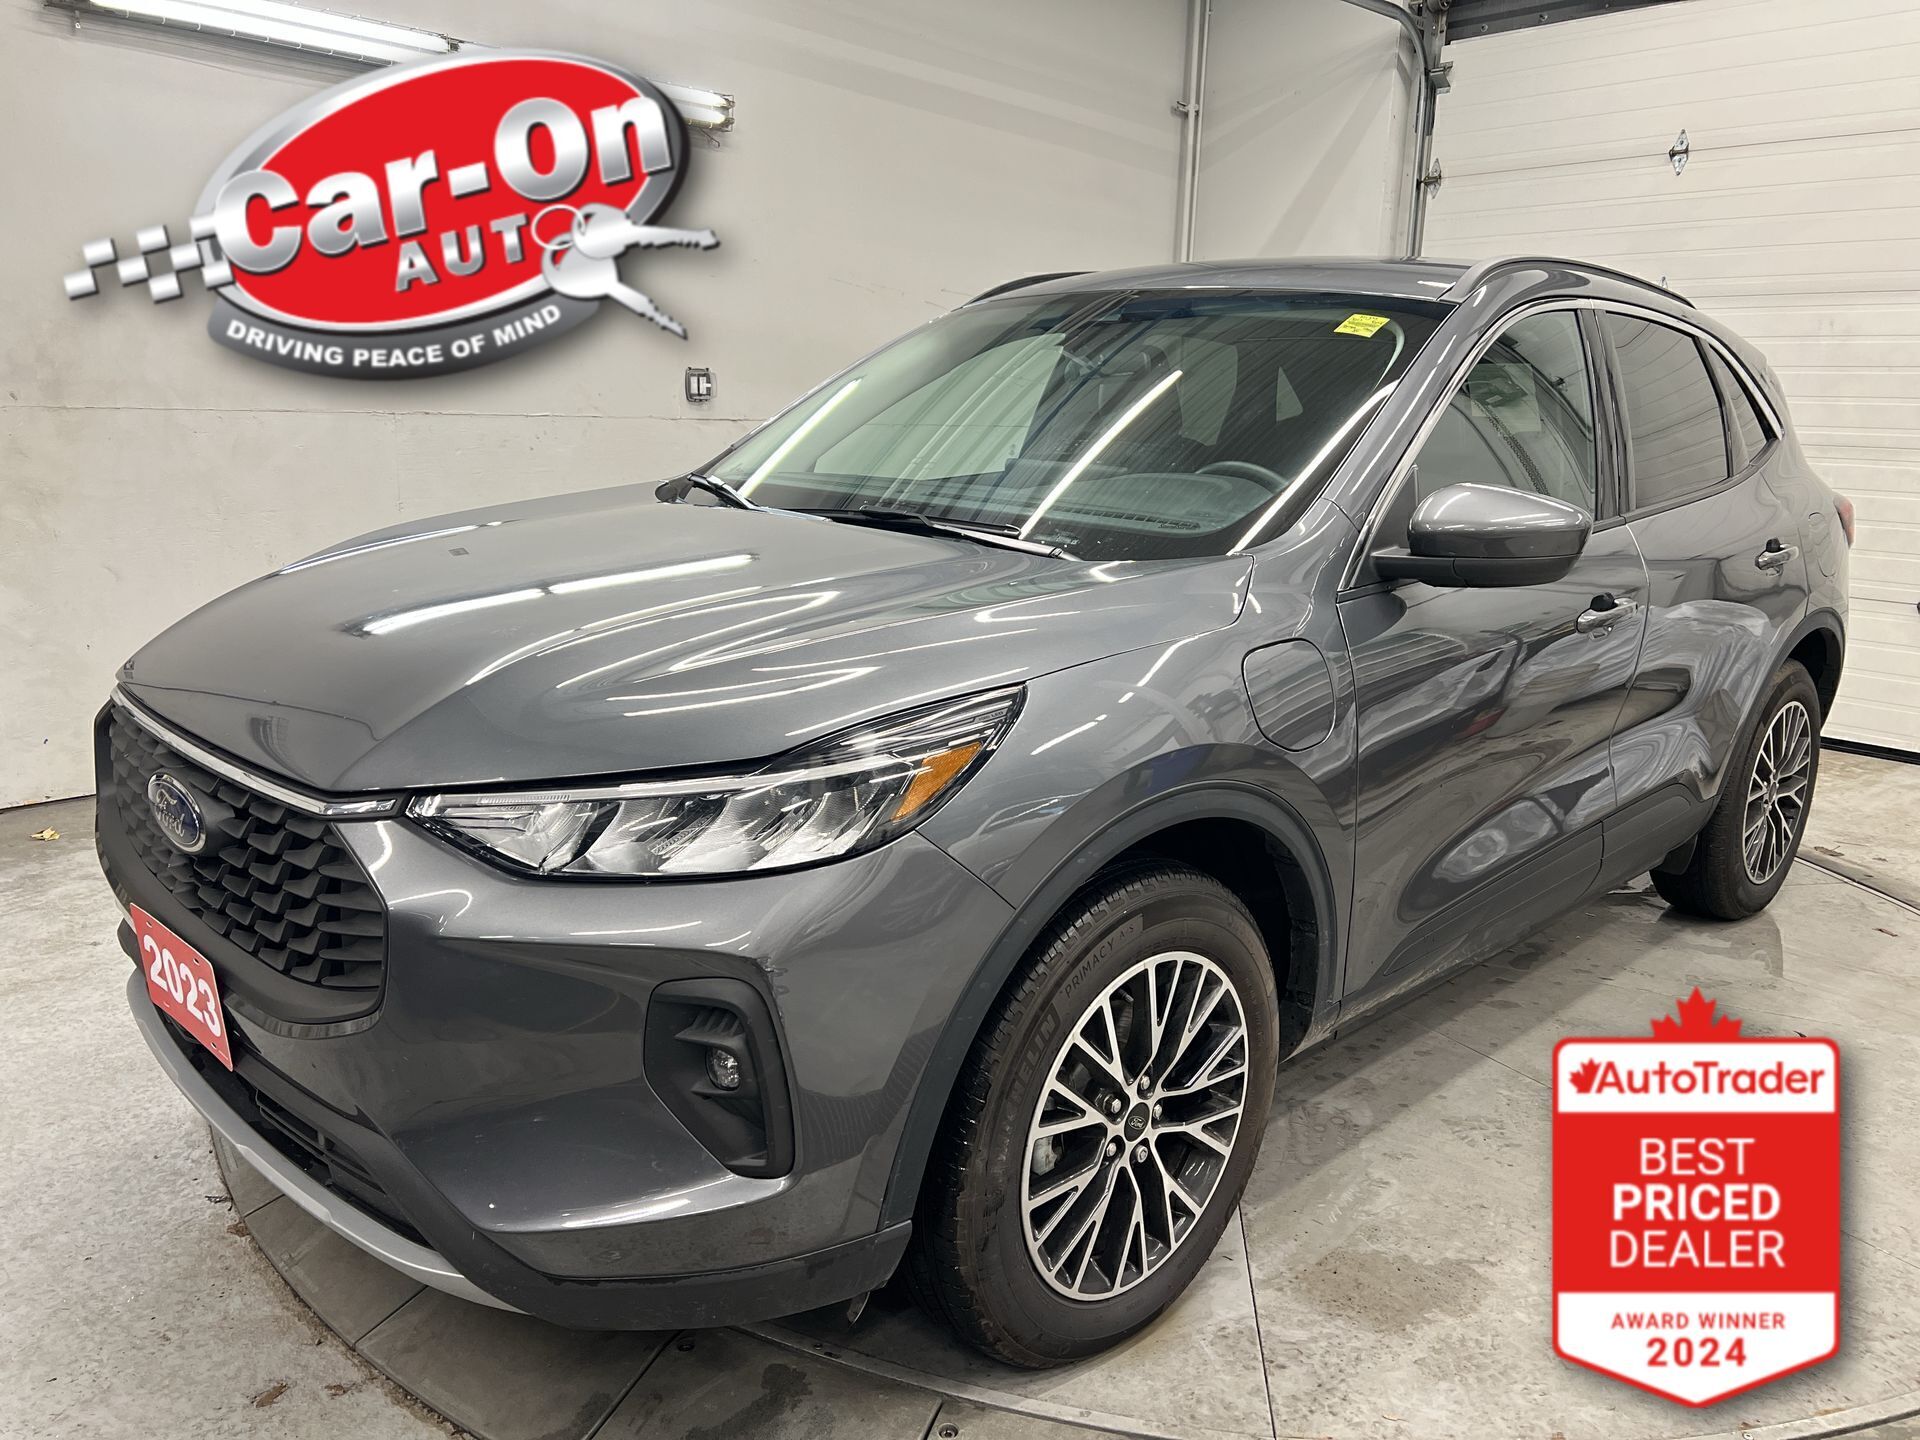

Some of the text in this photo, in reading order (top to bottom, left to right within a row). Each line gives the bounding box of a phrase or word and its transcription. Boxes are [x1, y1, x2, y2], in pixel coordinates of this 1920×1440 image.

[153, 788, 186, 838] Ford
[143, 934, 222, 1038] 2023
[1064, 938, 1115, 998] PRIMACY
